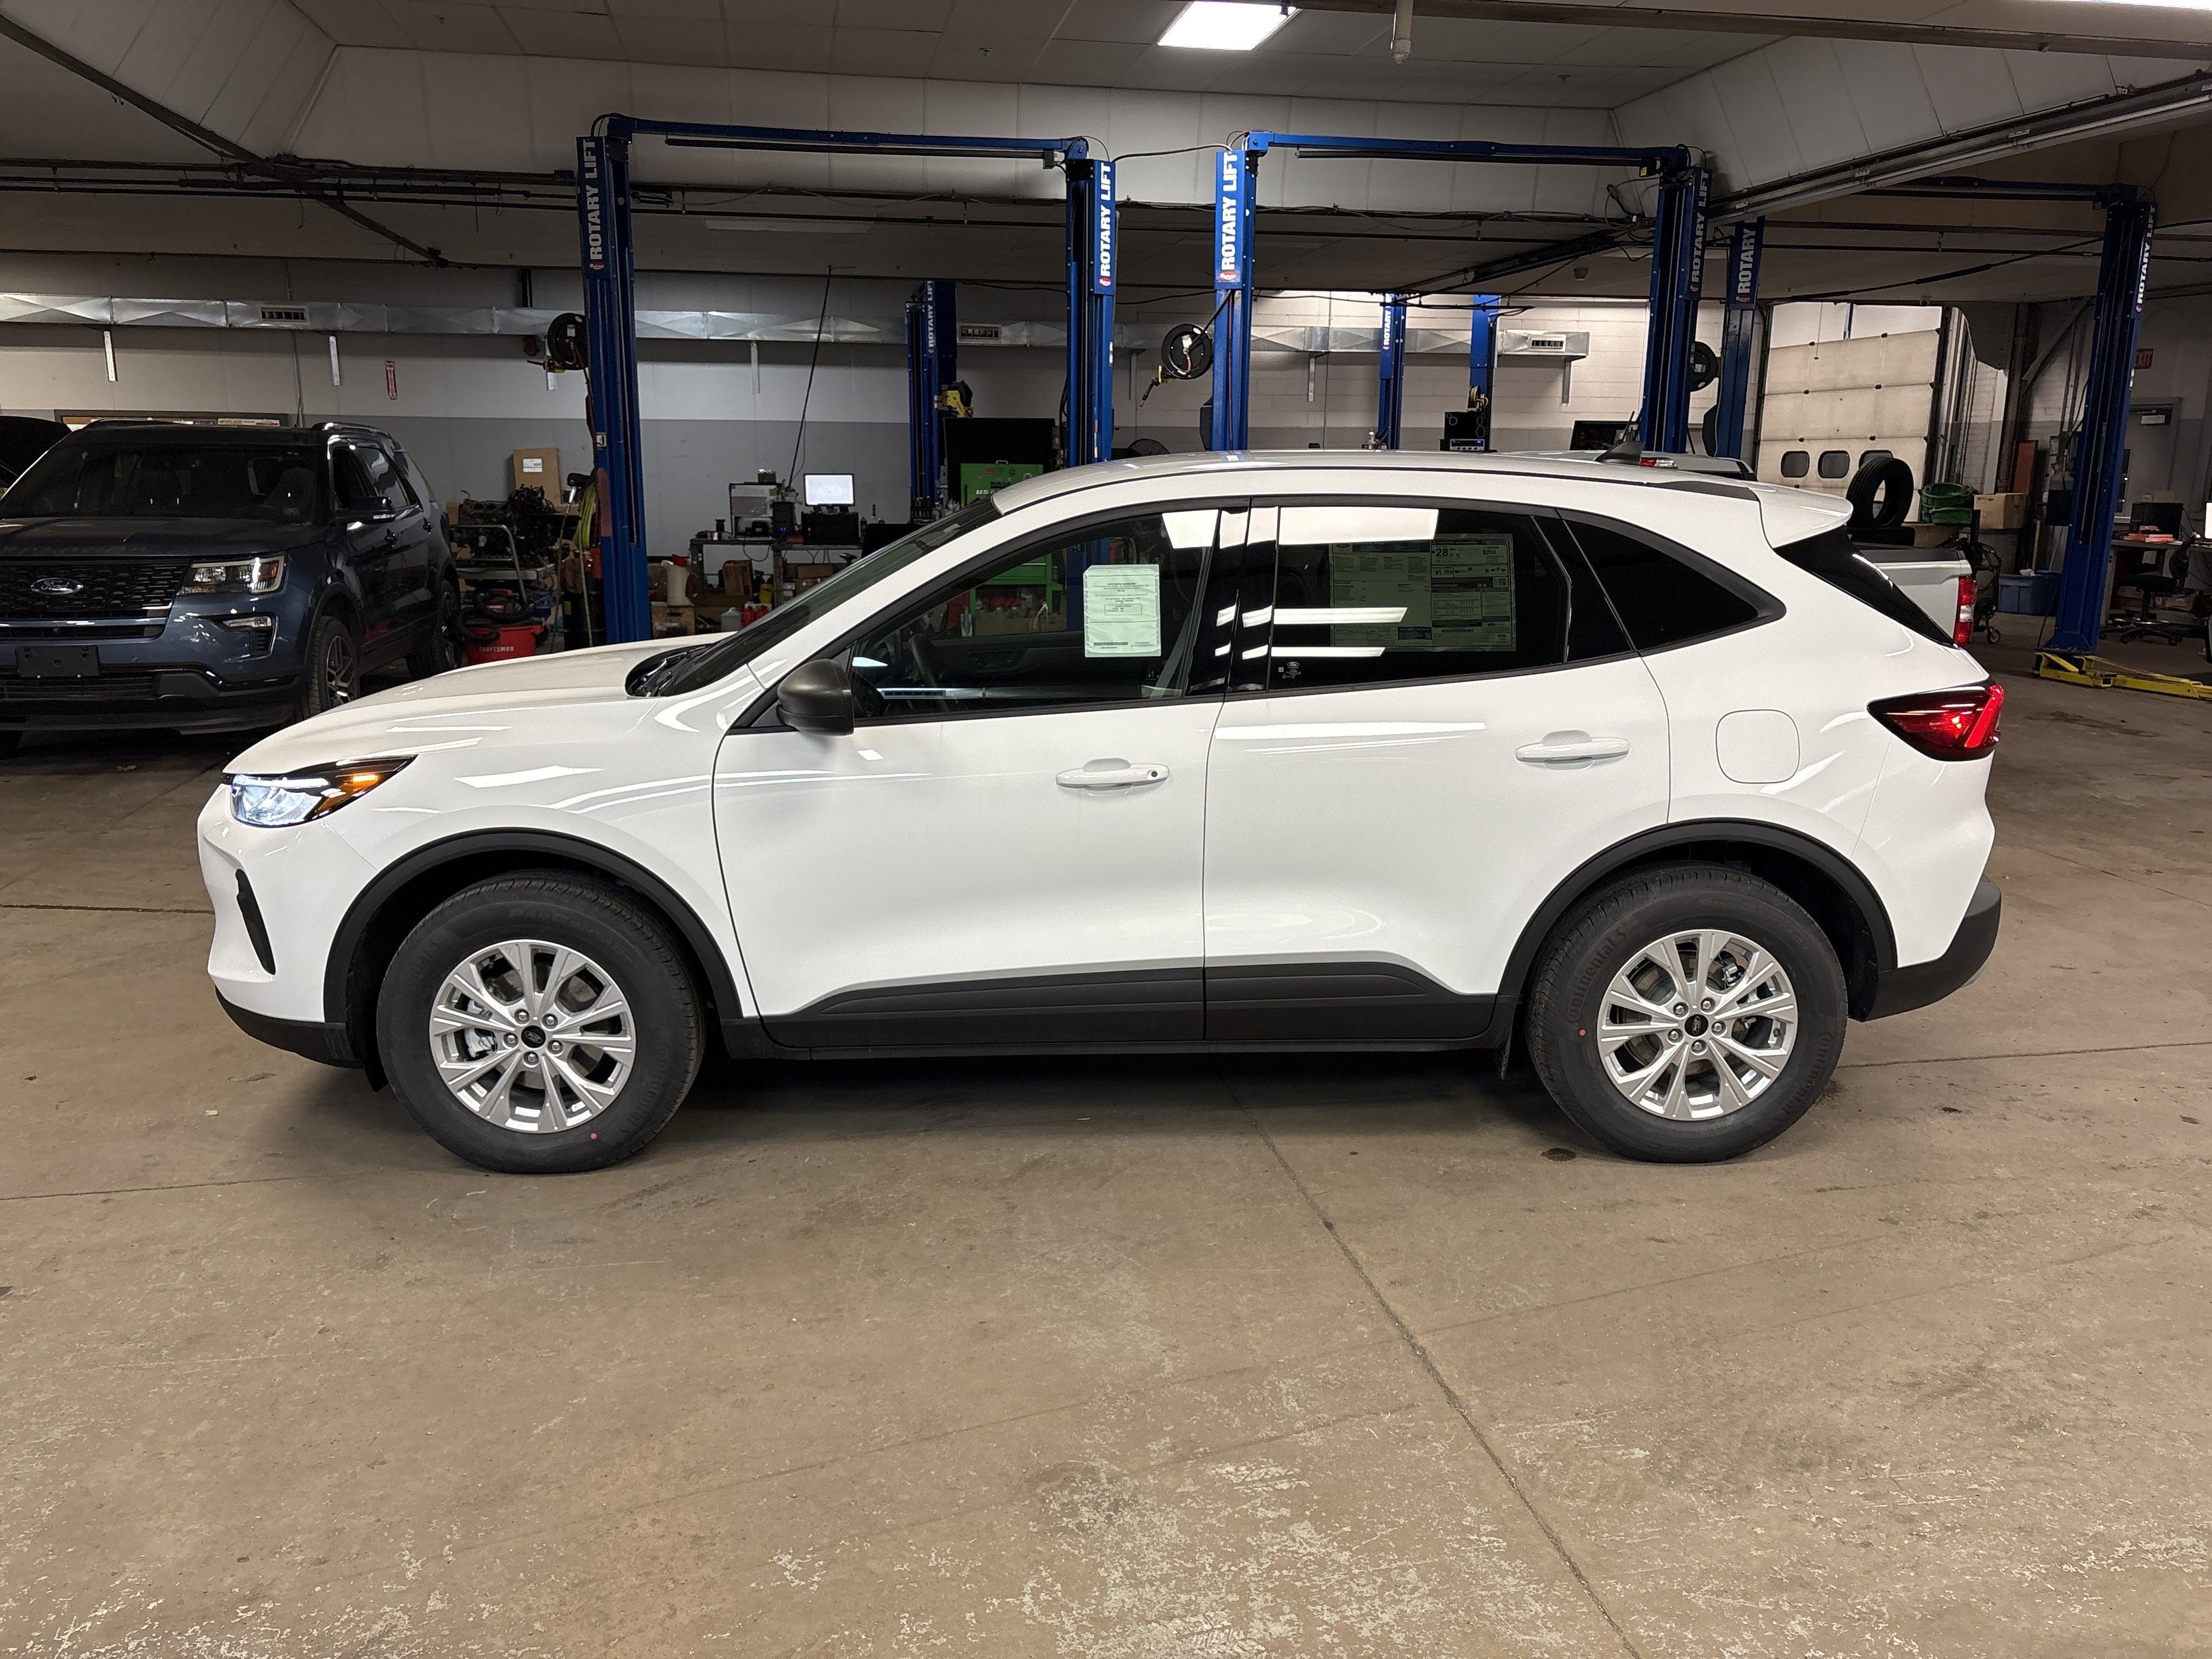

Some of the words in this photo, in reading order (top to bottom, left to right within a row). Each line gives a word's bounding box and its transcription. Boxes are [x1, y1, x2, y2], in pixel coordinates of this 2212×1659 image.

[583, 139, 598, 178] LIFT
[1101, 162, 1111, 201] LIFT
[1223, 151, 1238, 191] LIFT
[586, 185, 602, 259] ROTARY
[1101, 205, 1111, 276] ROTARY
[1222, 196, 1237, 270] ROTARY
[1691, 212, 1705, 283] ROTARY
[1699, 170, 1709, 207] LIFT
[1737, 228, 1756, 294] ROTARY
[2137, 242, 2151, 304] ROTARY
[2136, 351, 2153, 367] XIT
[1436, 548, 1448, 557] 28
[40, 580, 71, 591] Ford
